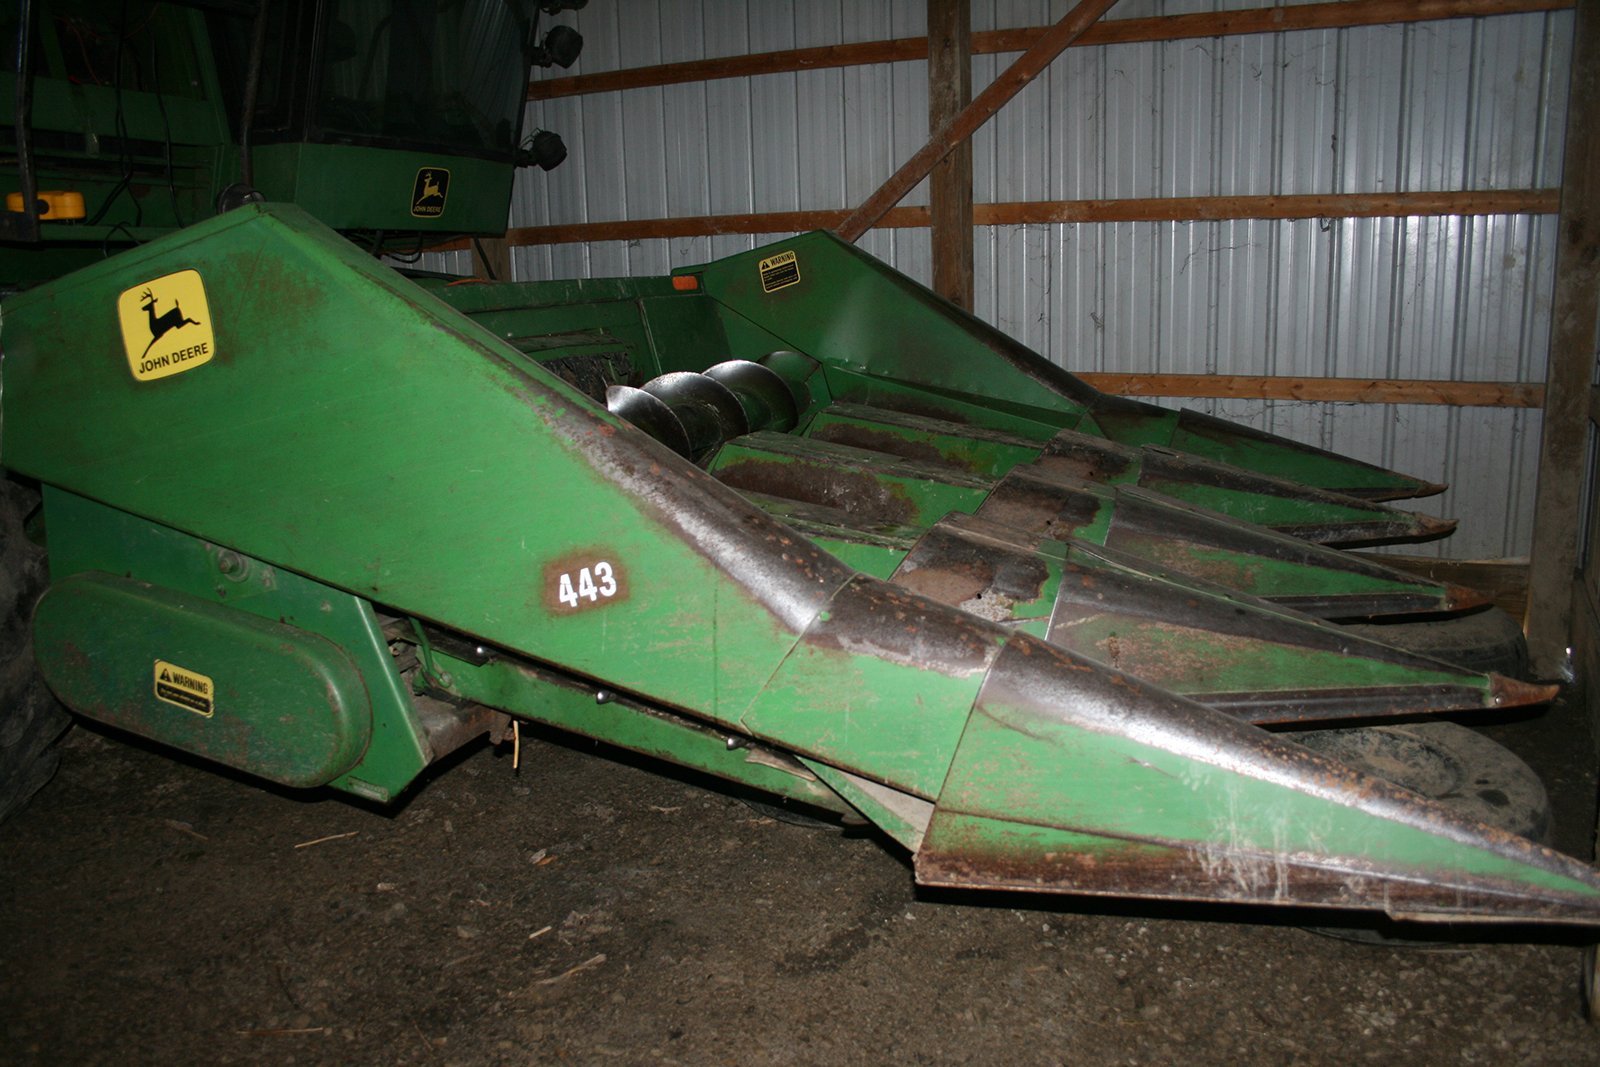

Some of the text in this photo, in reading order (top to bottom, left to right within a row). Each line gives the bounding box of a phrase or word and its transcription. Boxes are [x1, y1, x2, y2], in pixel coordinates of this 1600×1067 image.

[770, 252, 795, 266] WARNING
[139, 342, 209, 374] JOHN DEERE
[559, 561, 617, 608] 443
[172, 671, 208, 694] WARNING
